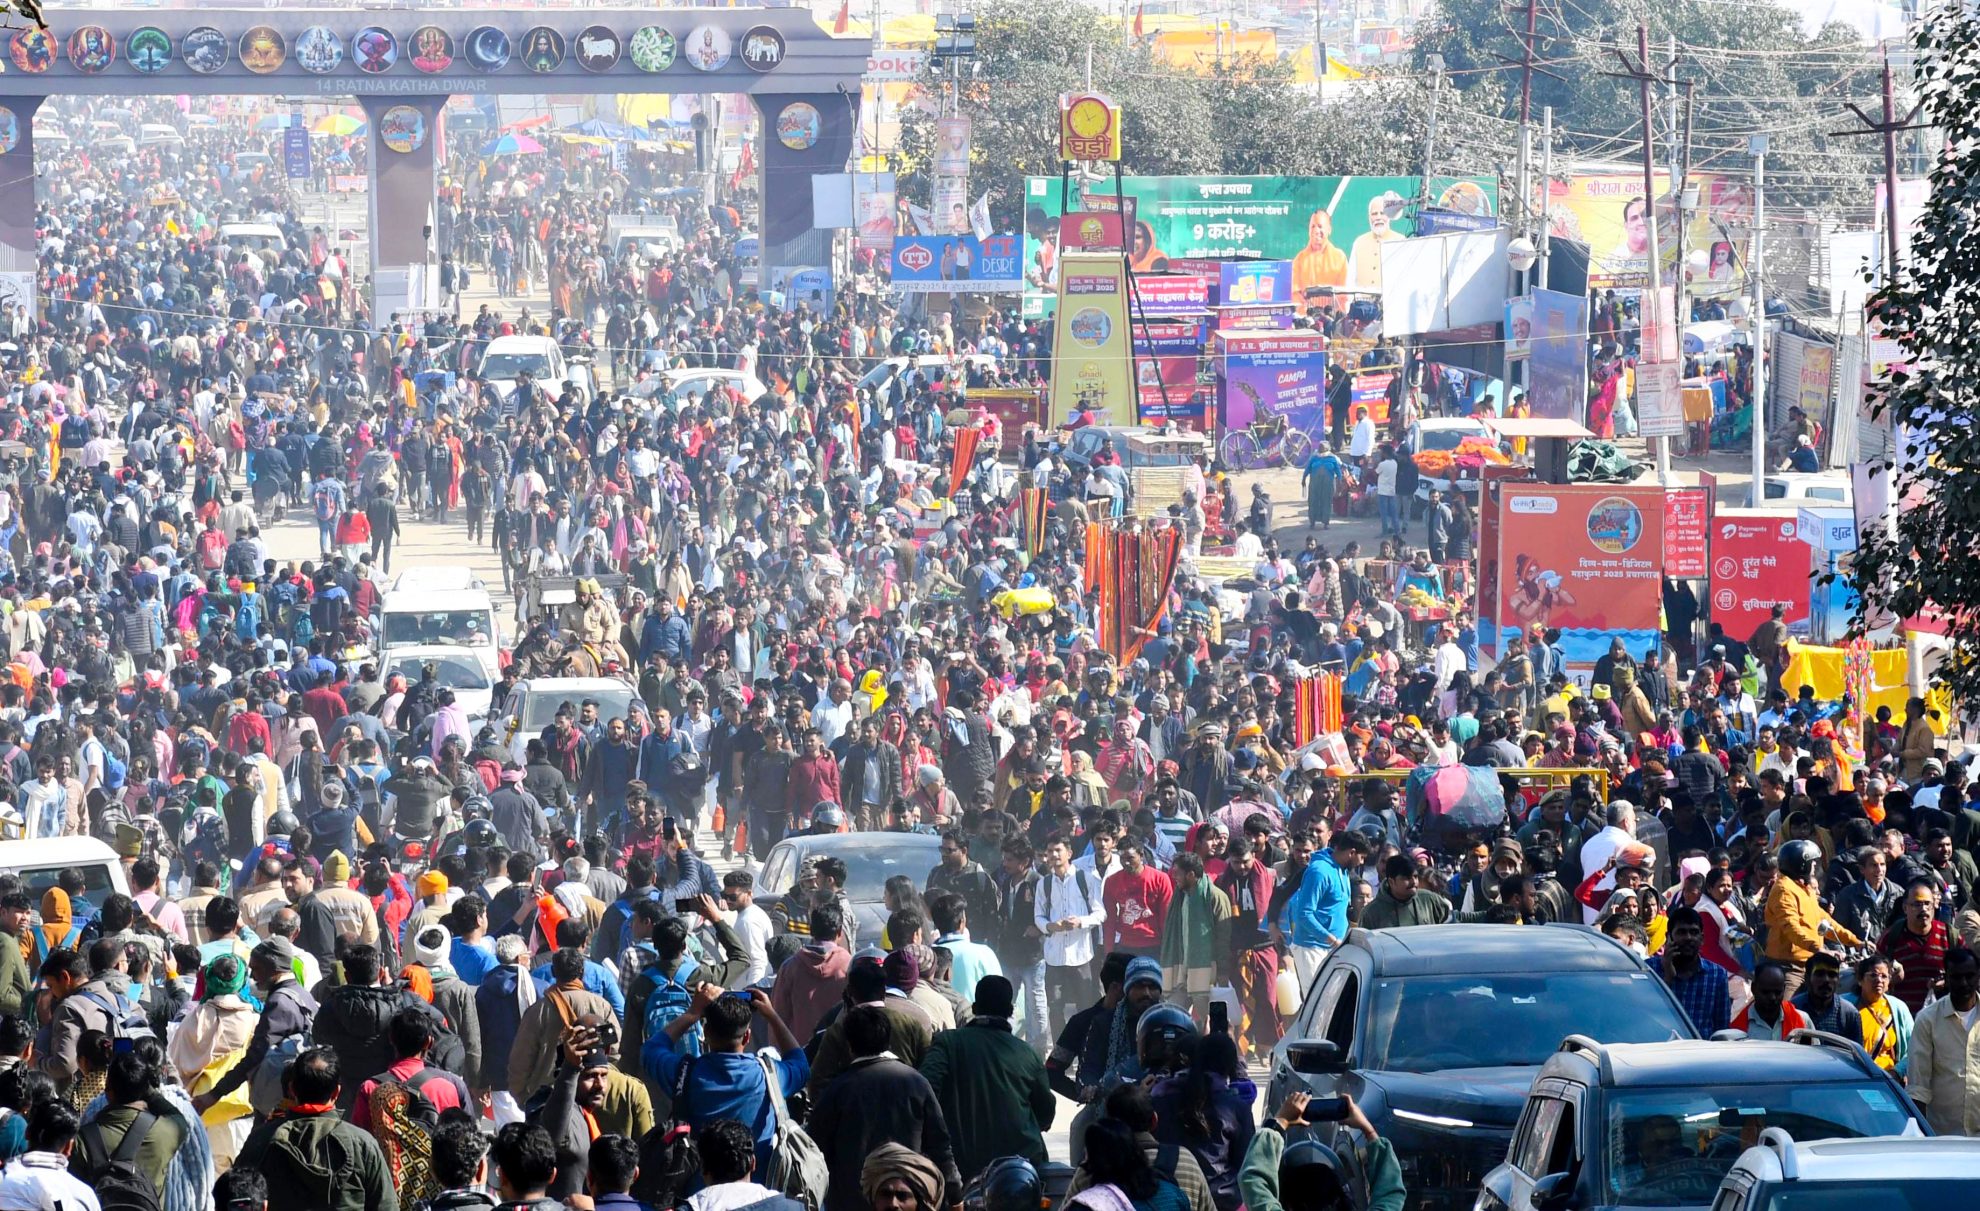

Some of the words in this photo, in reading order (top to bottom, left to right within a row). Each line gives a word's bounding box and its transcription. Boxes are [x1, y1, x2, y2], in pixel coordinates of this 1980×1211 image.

[316, 79, 331, 92] 14
[336, 79, 386, 92] RATNA
[389, 79, 438, 92] KATHA
[443, 79, 487, 92] DWAR
[1067, 133, 1112, 158] घड़ी
[1193, 224, 1204, 240] 9
[982, 258, 1014, 273] DESIRE
[1095, 284, 1115, 292] 2025
[1277, 370, 1307, 384] CAMPA
[1742, 557, 1760, 568] तुरंत
[1763, 556, 1777, 567] पैसे
[1603, 570, 1623, 578] 2025
